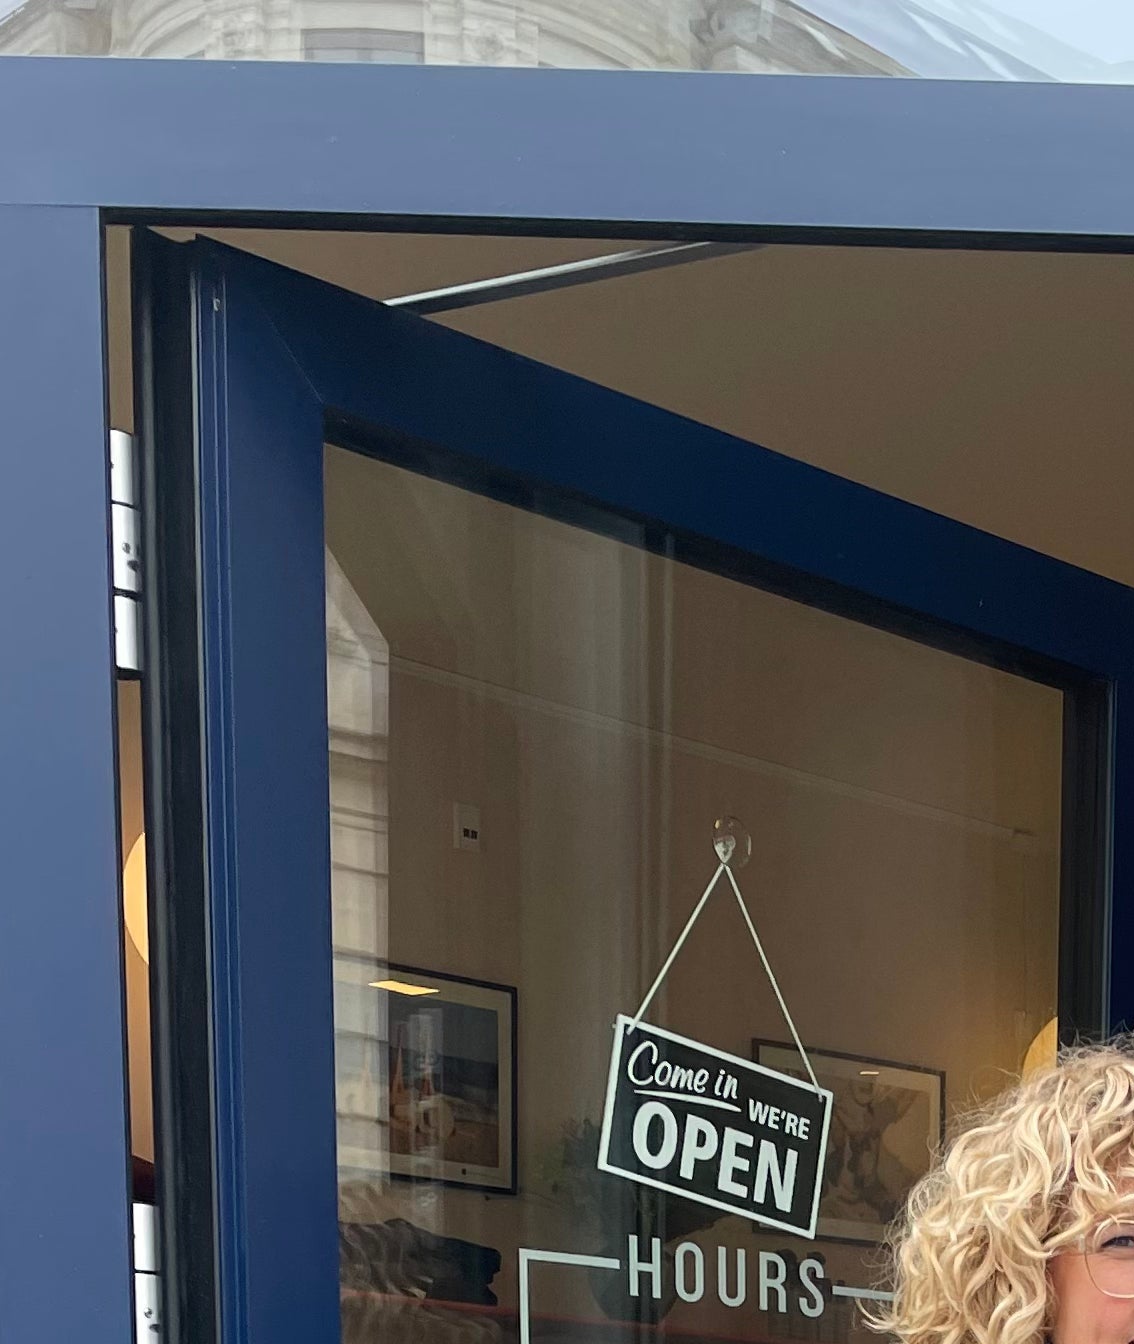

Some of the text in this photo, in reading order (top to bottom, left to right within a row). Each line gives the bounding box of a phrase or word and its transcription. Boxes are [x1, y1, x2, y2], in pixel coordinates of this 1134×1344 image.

[627, 1041, 811, 1140] Come in WE'RE
[632, 1101, 799, 1213] OPEN
[628, 1234, 825, 1318] HOURS
